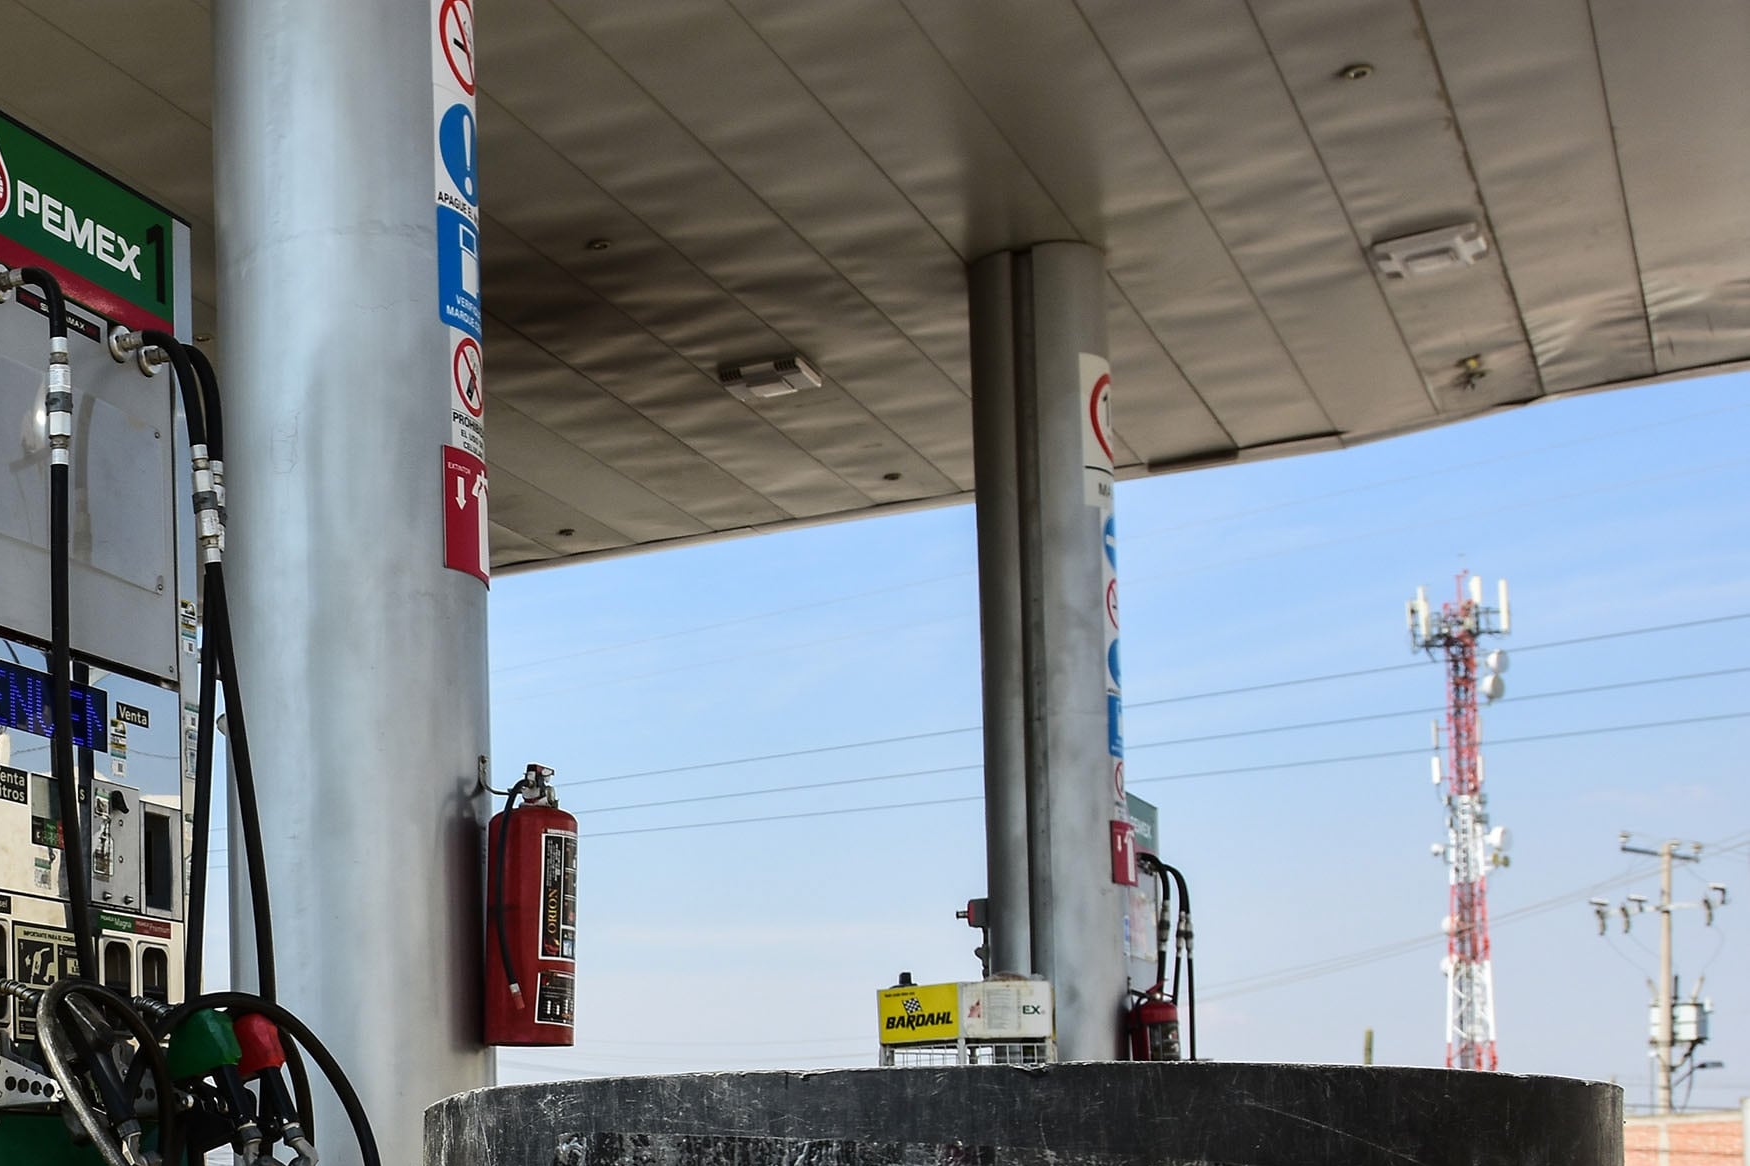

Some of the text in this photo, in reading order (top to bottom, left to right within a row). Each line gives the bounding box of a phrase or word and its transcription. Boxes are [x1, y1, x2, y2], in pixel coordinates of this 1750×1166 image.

[17, 180, 165, 304] PEMEX 1
[119, 703, 148, 726] Venta
[547, 888, 559, 934] ORION
[886, 1012, 953, 1031] BARDAHL
